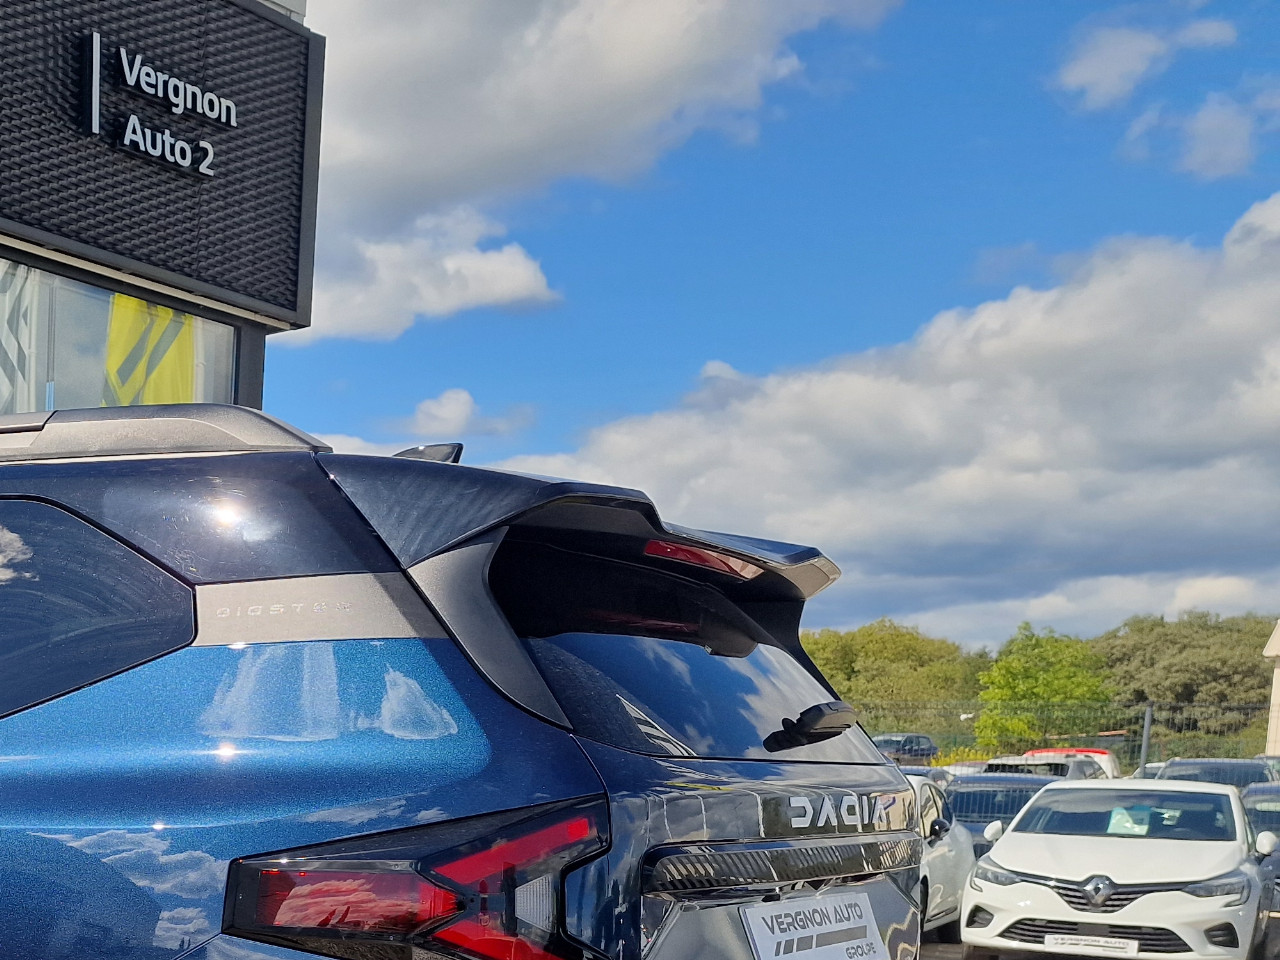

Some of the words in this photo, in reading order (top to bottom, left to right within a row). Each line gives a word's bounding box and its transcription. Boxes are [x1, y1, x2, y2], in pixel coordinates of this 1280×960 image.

[119, 46, 238, 128] Vergnon
[124, 114, 192, 168] Auto
[198, 140, 215, 177] 2
[789, 795, 887, 828] DACIA
[761, 906, 833, 935] VERGNON
[833, 902, 864, 924] AUTO
[845, 942, 877, 960] GROUPE
